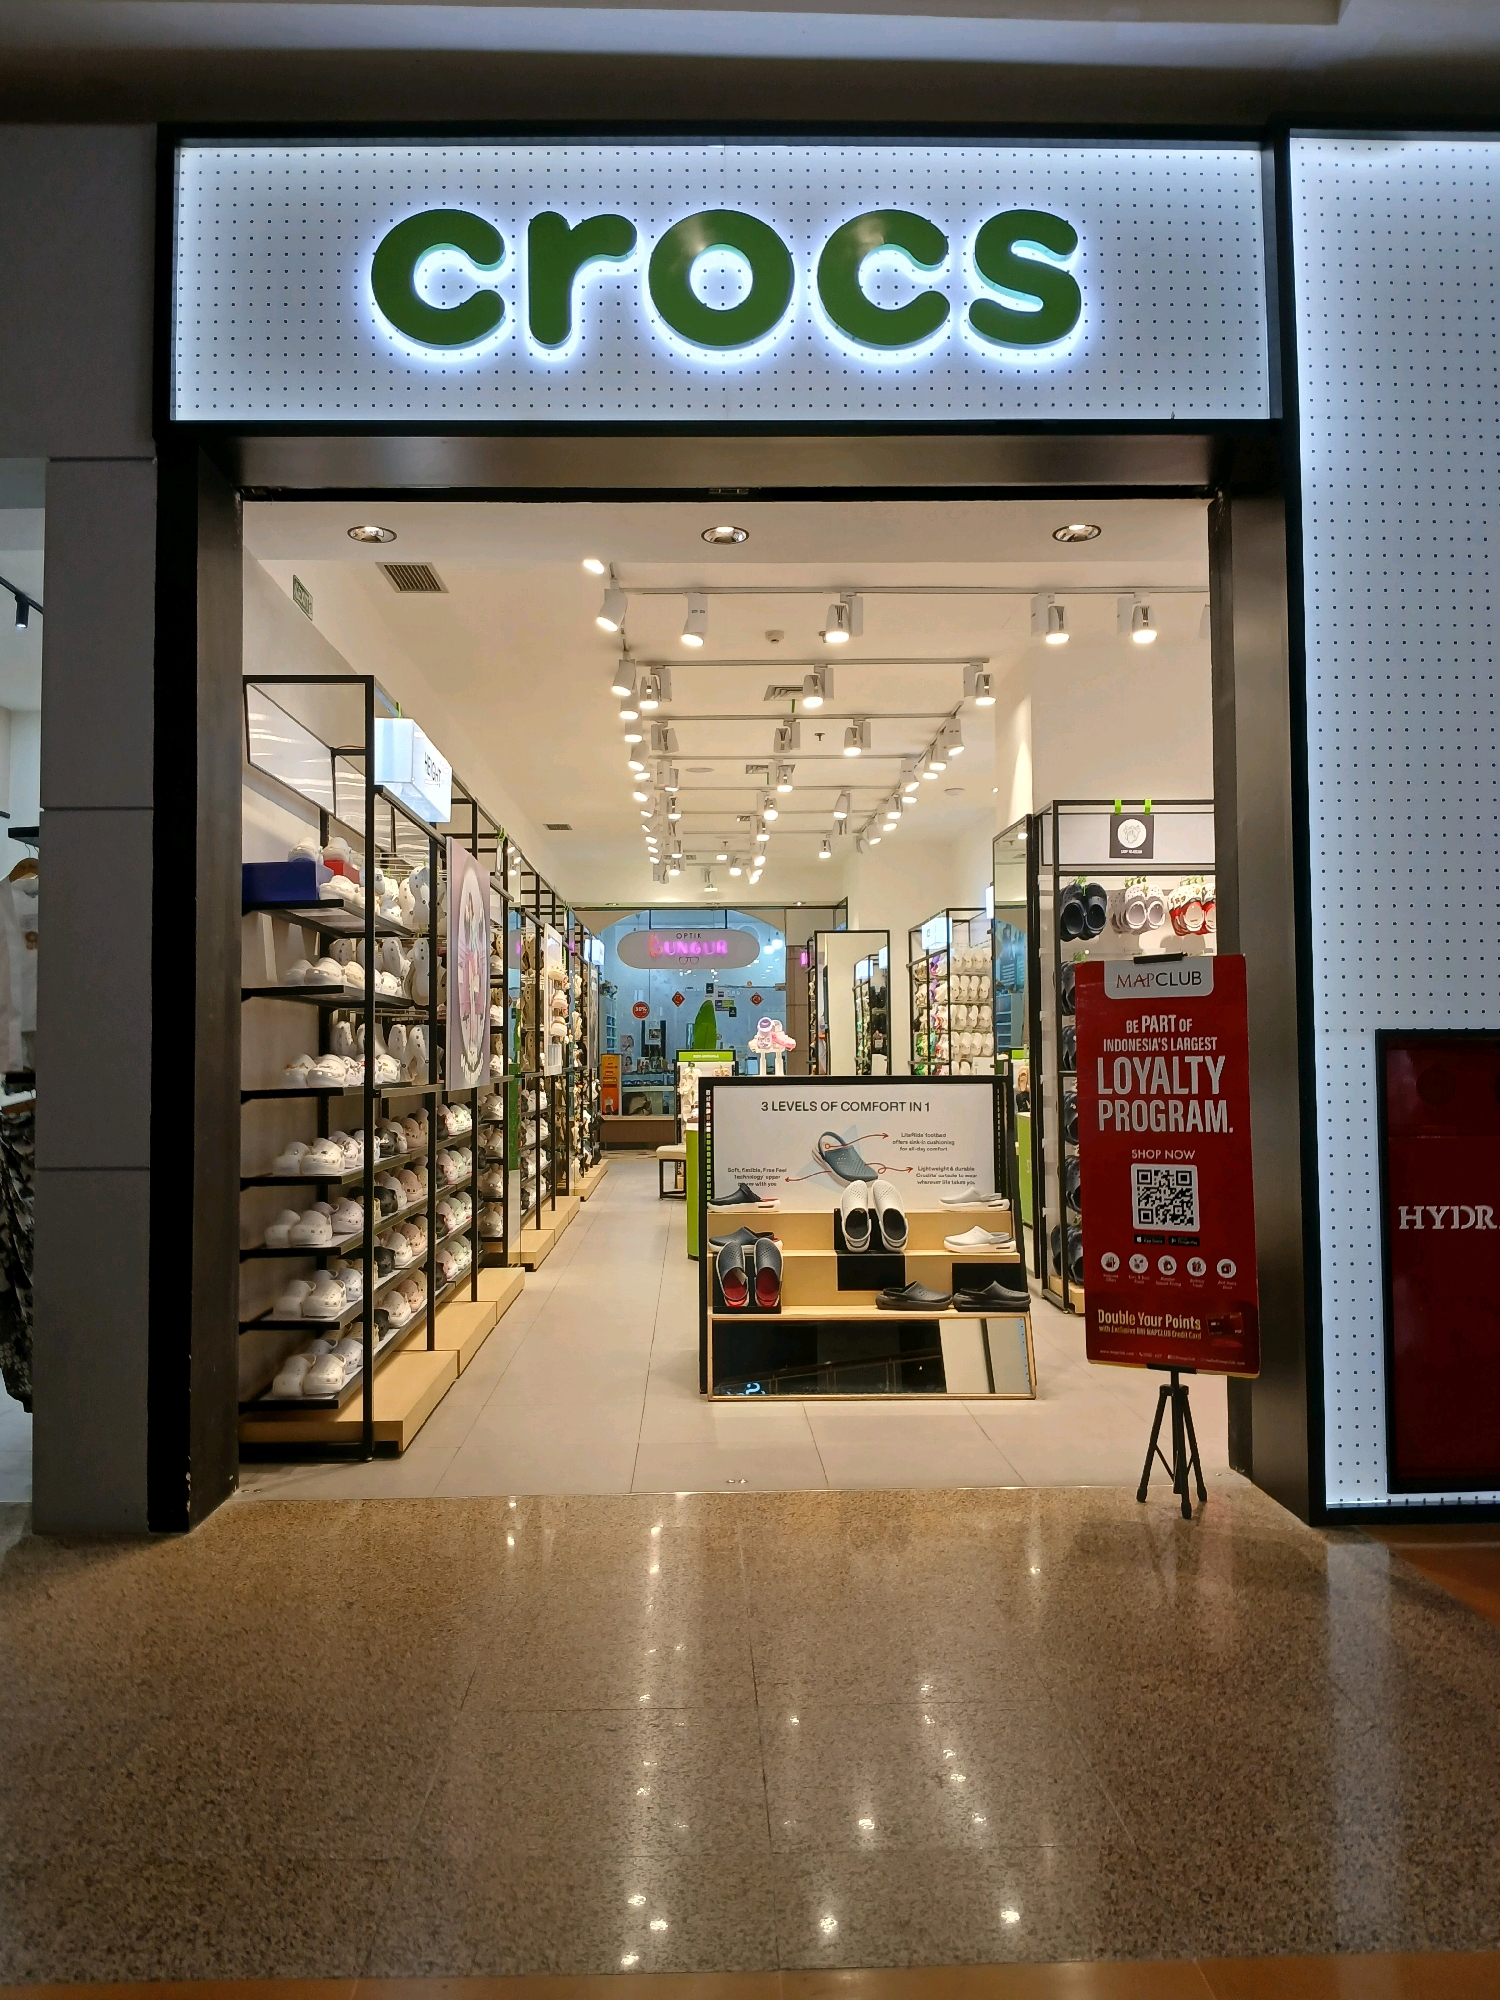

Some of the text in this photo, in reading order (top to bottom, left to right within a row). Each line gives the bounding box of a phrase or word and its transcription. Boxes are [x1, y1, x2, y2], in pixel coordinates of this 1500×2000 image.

[371, 209, 1083, 350] crocs
[1116, 971, 1202, 988] MAPCLUB
[1126, 1014, 1193, 1033] BE PART OF
[1104, 1037, 1217, 1052] INDONESIA'S LARGEST
[1097, 1056, 1226, 1094] LOYALTY
[761, 1101, 930, 1112] 3 LEVELS OF COMFORT IN 1
[1098, 1100, 1234, 1133] PROGRAM.
[1132, 1149, 1196, 1159] SHOP NOW
[1398, 1205, 1500, 1230] HYDR
[1098, 1309, 1201, 1330] Double Your Points
[1189, 1330, 1202, 1340] Card
